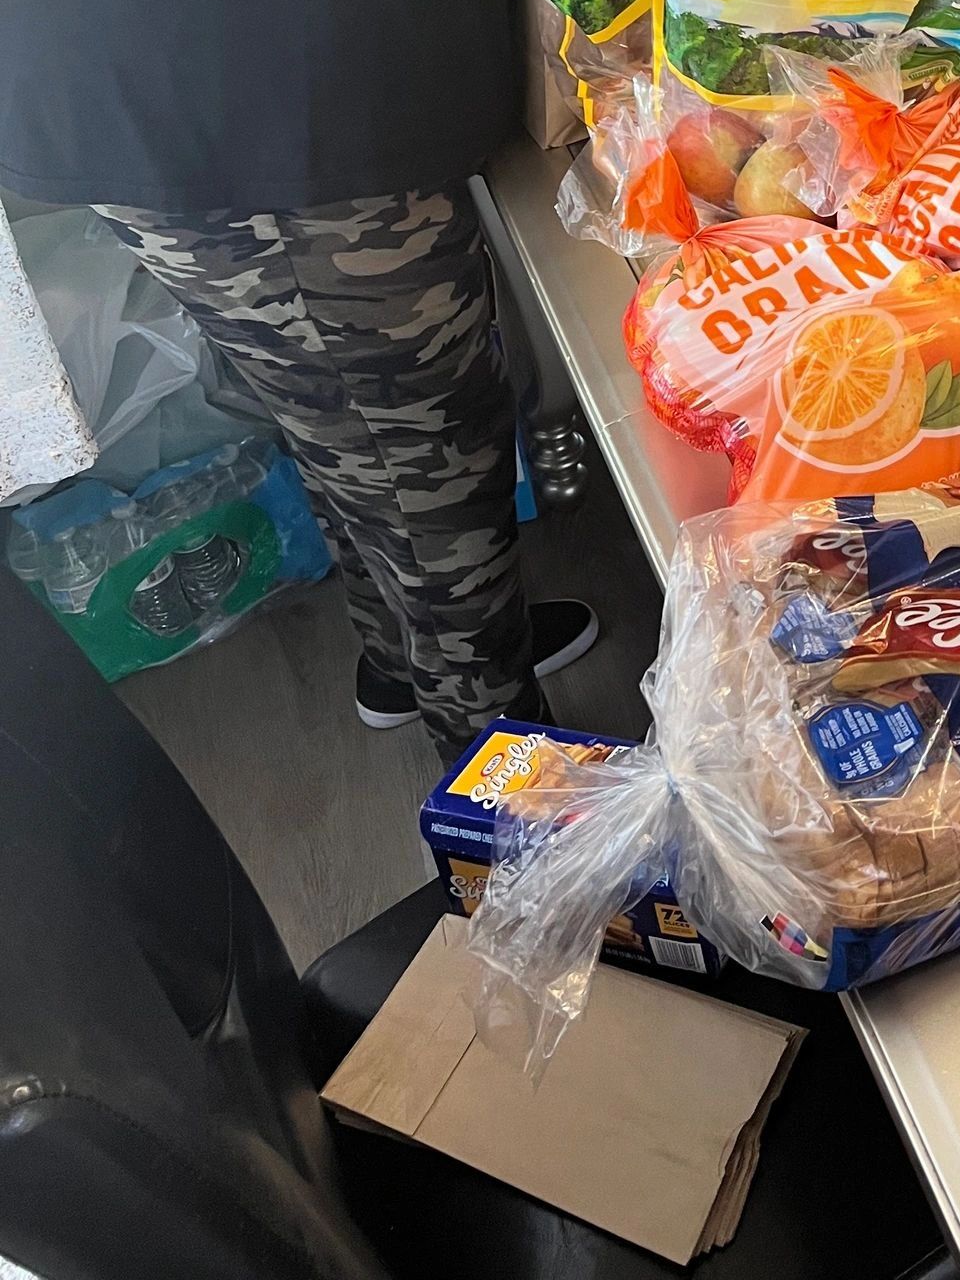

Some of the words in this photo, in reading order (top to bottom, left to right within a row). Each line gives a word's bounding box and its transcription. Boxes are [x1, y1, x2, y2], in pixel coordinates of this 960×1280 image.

[849, 747, 870, 775] WHOLE
[861, 740, 883, 770] GRAINS
[469, 732, 546, 810] Singles
[660, 908, 688, 923] 72
[663, 920, 690, 929] SLICES
